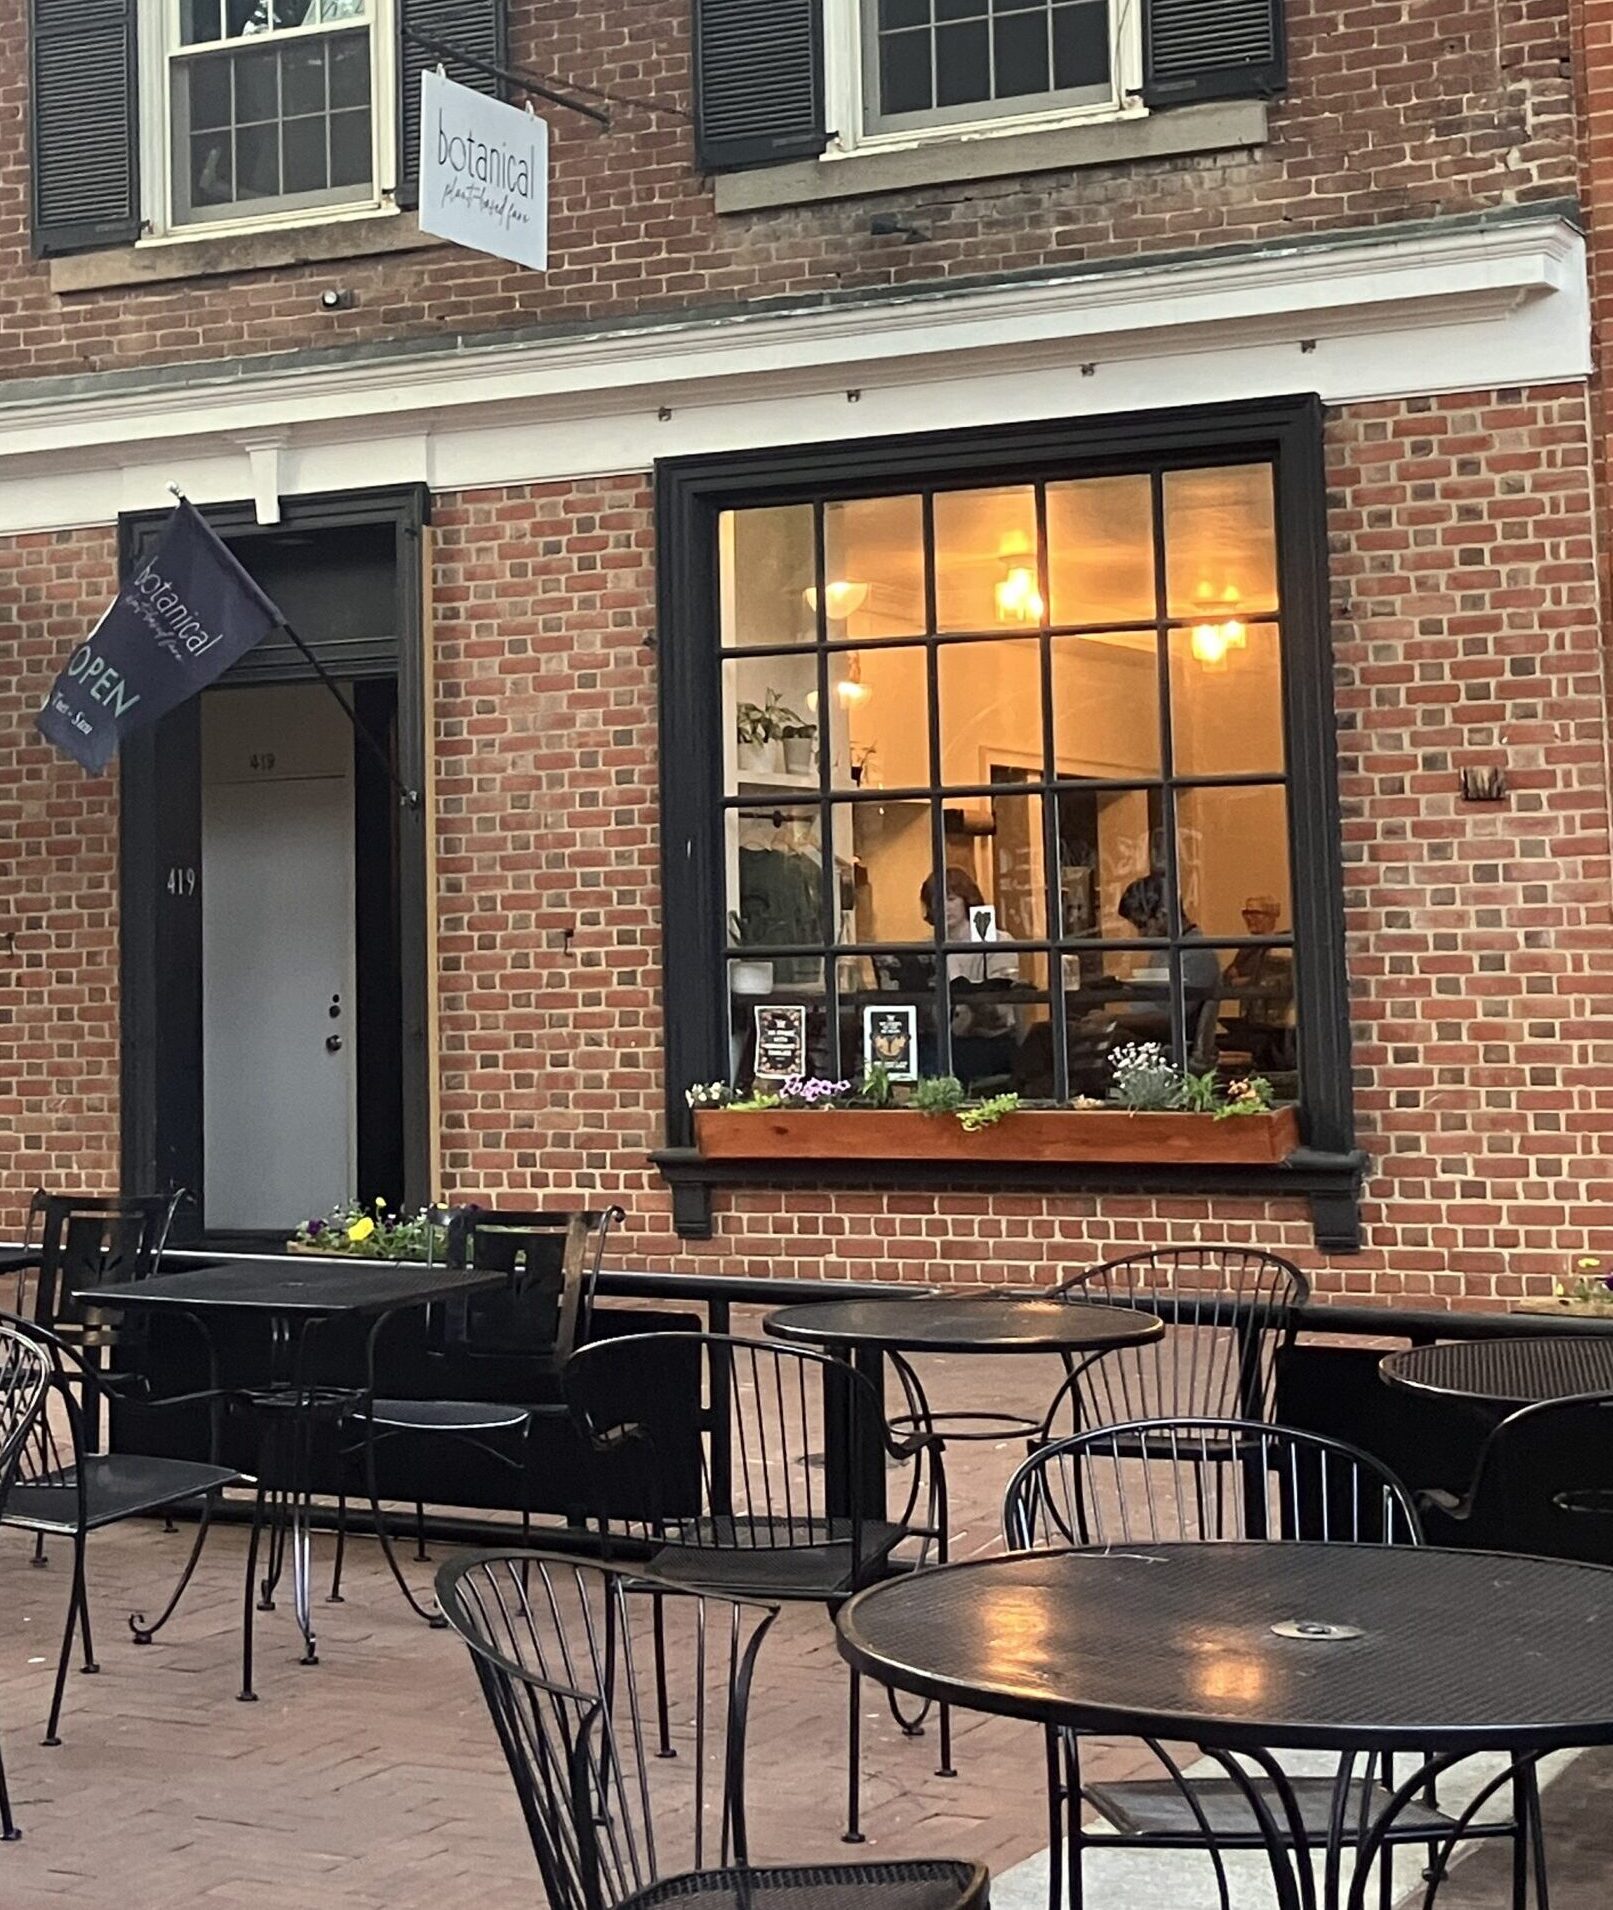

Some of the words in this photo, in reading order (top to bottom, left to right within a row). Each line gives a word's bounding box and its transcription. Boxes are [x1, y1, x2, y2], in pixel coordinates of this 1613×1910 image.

[437, 107, 535, 200] botanical
[133, 555, 223, 657] botanical
[67, 645, 141, 719] OPEN
[167, 867, 195, 896] 419
